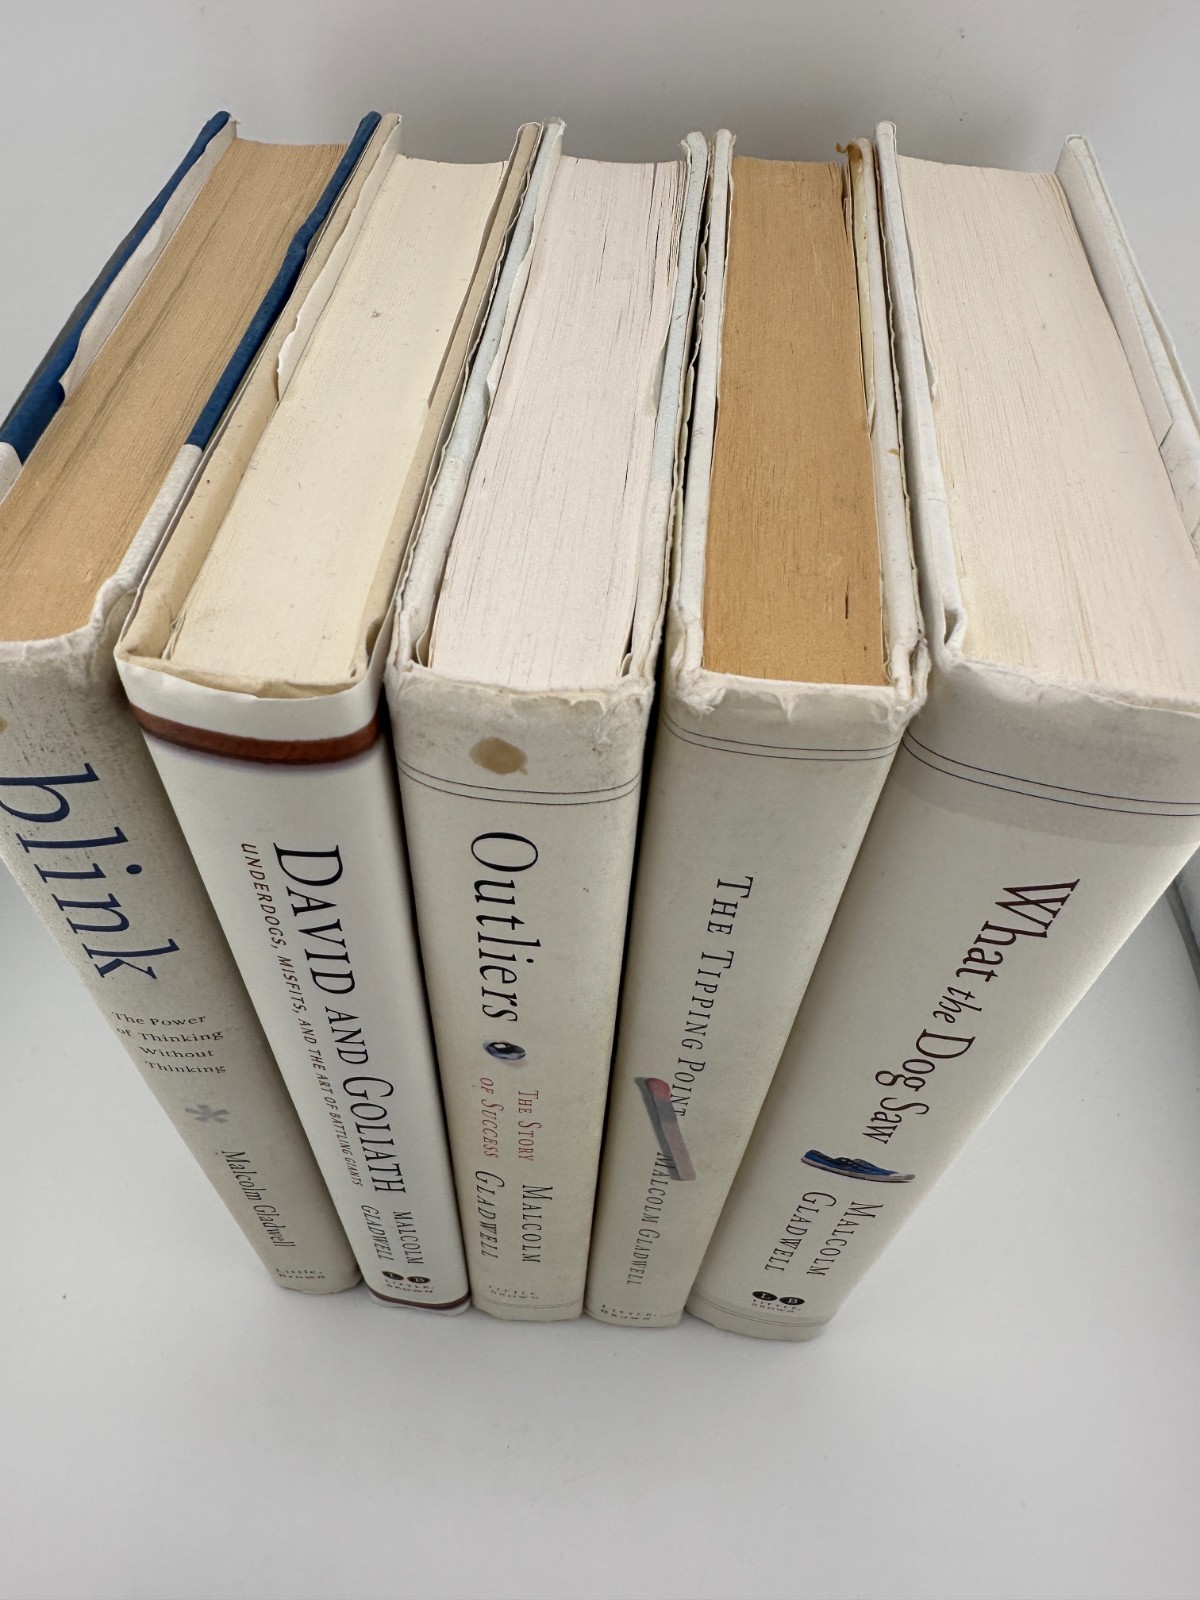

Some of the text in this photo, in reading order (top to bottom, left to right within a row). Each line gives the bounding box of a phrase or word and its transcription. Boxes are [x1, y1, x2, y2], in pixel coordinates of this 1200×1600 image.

[0, 762, 180, 980] blink
[470, 832, 542, 1022] Outliers
[111, 1011, 206, 1026] The Power
[240, 842, 363, 1187] UNDERDOGS, MISFITS, AND THE ART OF BATTLING GIANTS
[272, 842, 407, 1194] DAVID AND GOLIATH
[670, 875, 754, 1117] THE TIPPING POINT
[862, 878, 1081, 1145] What the Dog Saw
[138, 1031, 224, 1042] Thinking
[138, 1046, 215, 1058] Without
[144, 1060, 226, 1074] Thinking
[480, 1077, 504, 1158] OF SUCCESS
[518, 1090, 542, 1162] THE STORY
[221, 1150, 296, 1248] Malcolm Gladwell
[361, 1205, 394, 1260] GLADWELL
[393, 1211, 424, 1264] MALCOLM
[475, 1170, 505, 1258] GLADWELL
[522, 1184, 553, 1263] MALCOLM
[764, 1191, 837, 1272] GLADWELL
[806, 1201, 884, 1276] MALCOLM
[626, 1228, 661, 1286] GLADWELL
